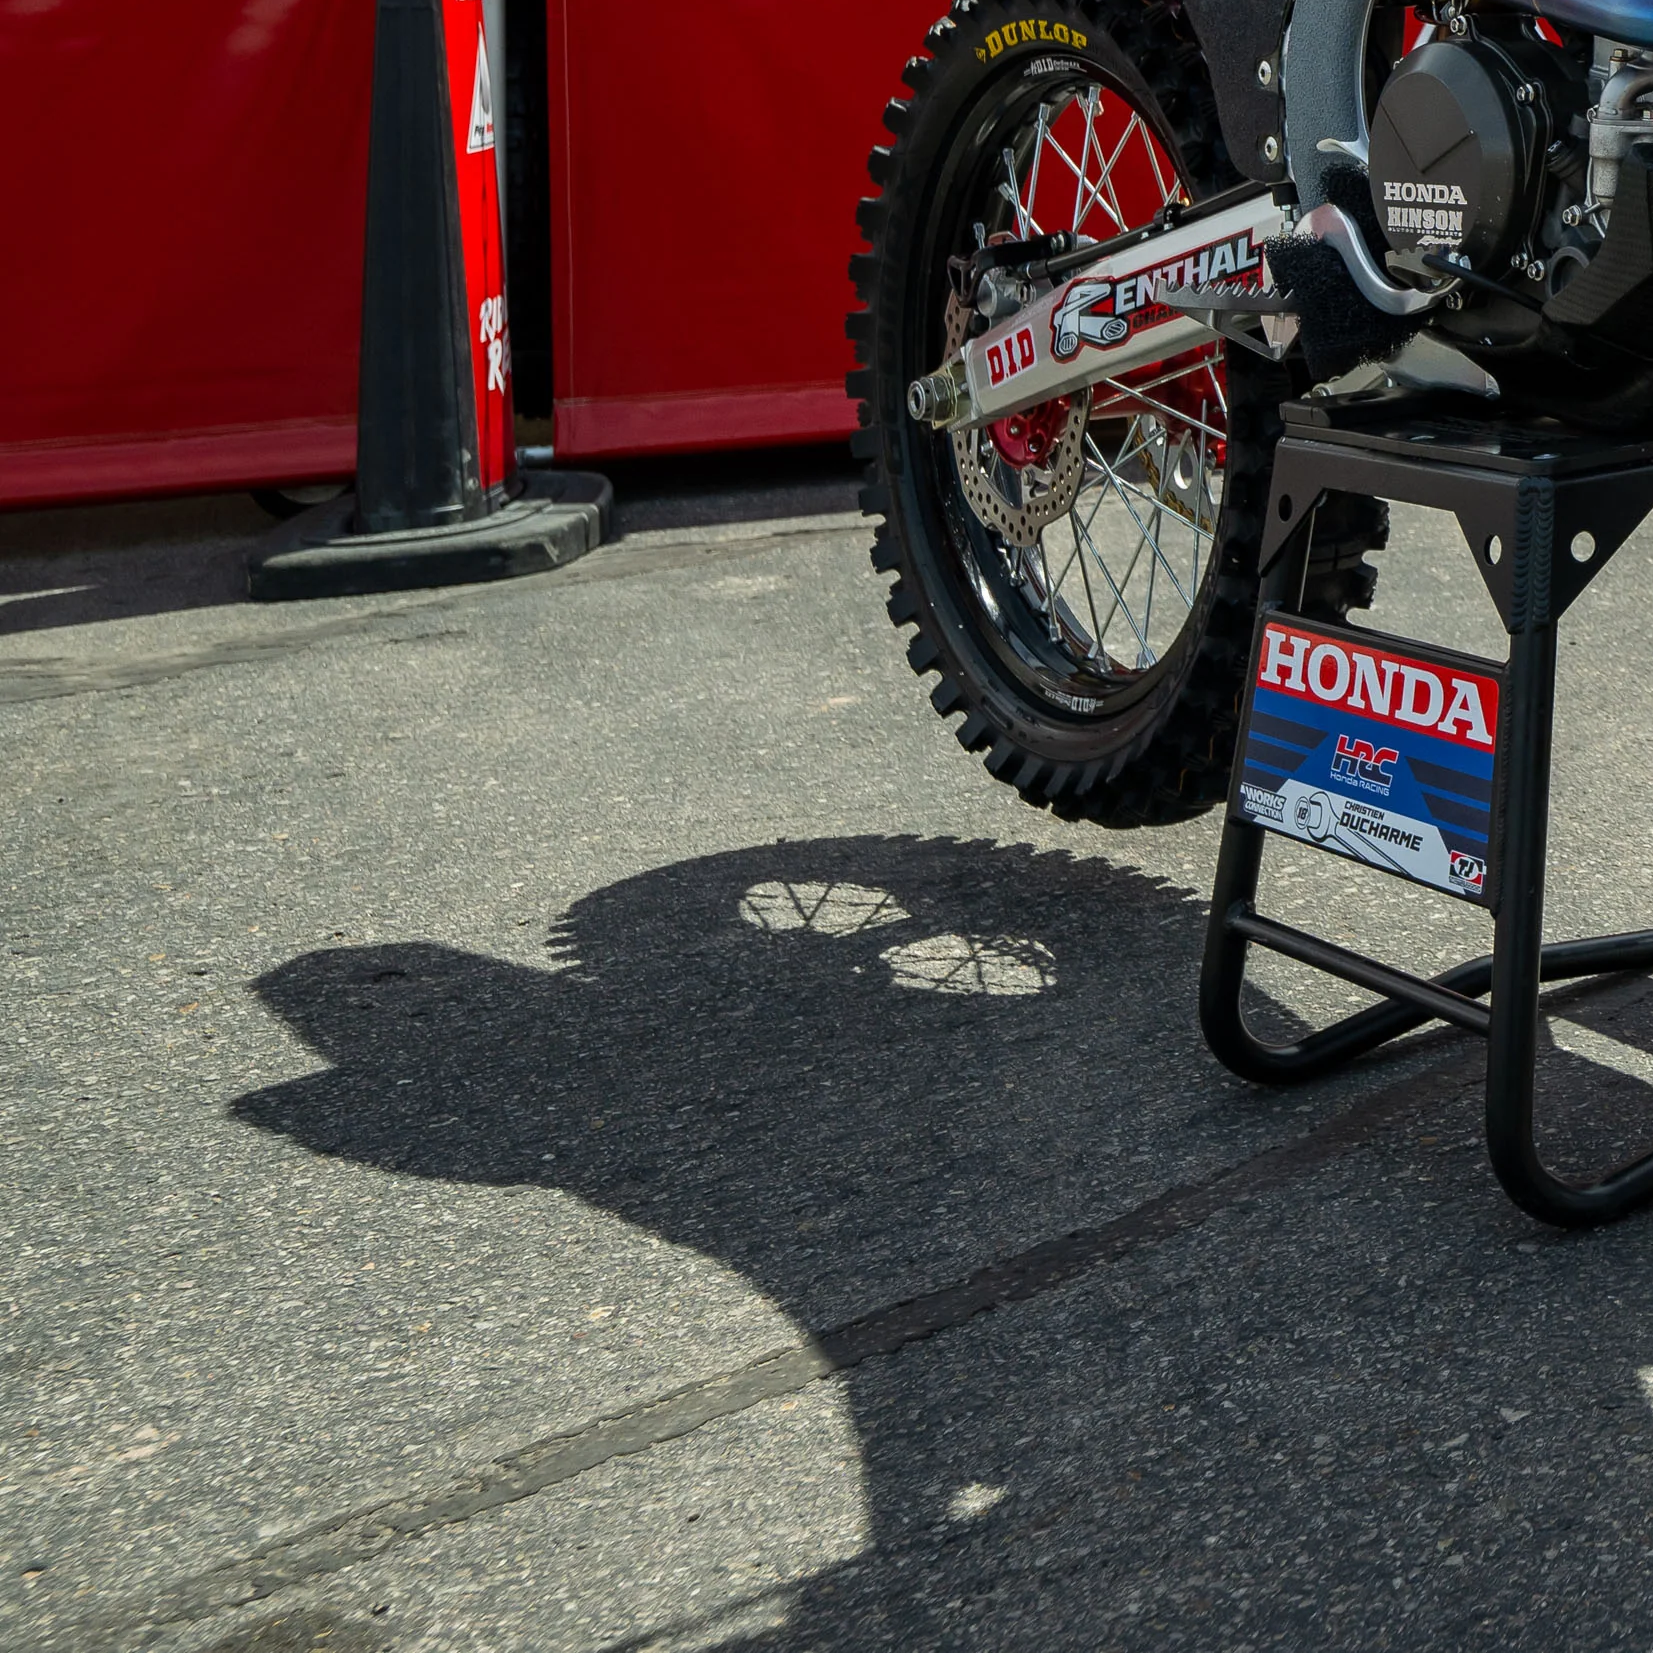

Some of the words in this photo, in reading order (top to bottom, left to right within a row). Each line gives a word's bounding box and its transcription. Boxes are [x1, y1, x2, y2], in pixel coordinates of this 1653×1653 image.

[985, 19, 1088, 59] DUNLOP
[1384, 182, 1468, 205] HONDA
[1388, 207, 1463, 231] HINSON
[986, 329, 1035, 386] D.I.D
[1260, 629, 1492, 745] HONDA
[1331, 734, 1399, 786] HRC
[1330, 771, 1358, 788] Honda
[1358, 780, 1390, 796] RACING
[1243, 785, 1287, 810] WORKS
[1244, 801, 1283, 821] CONNECTION
[1296, 806, 1308, 820] 18
[1344, 800, 1385, 821] CHRISTIEN
[1339, 811, 1423, 852] DUCHARME
